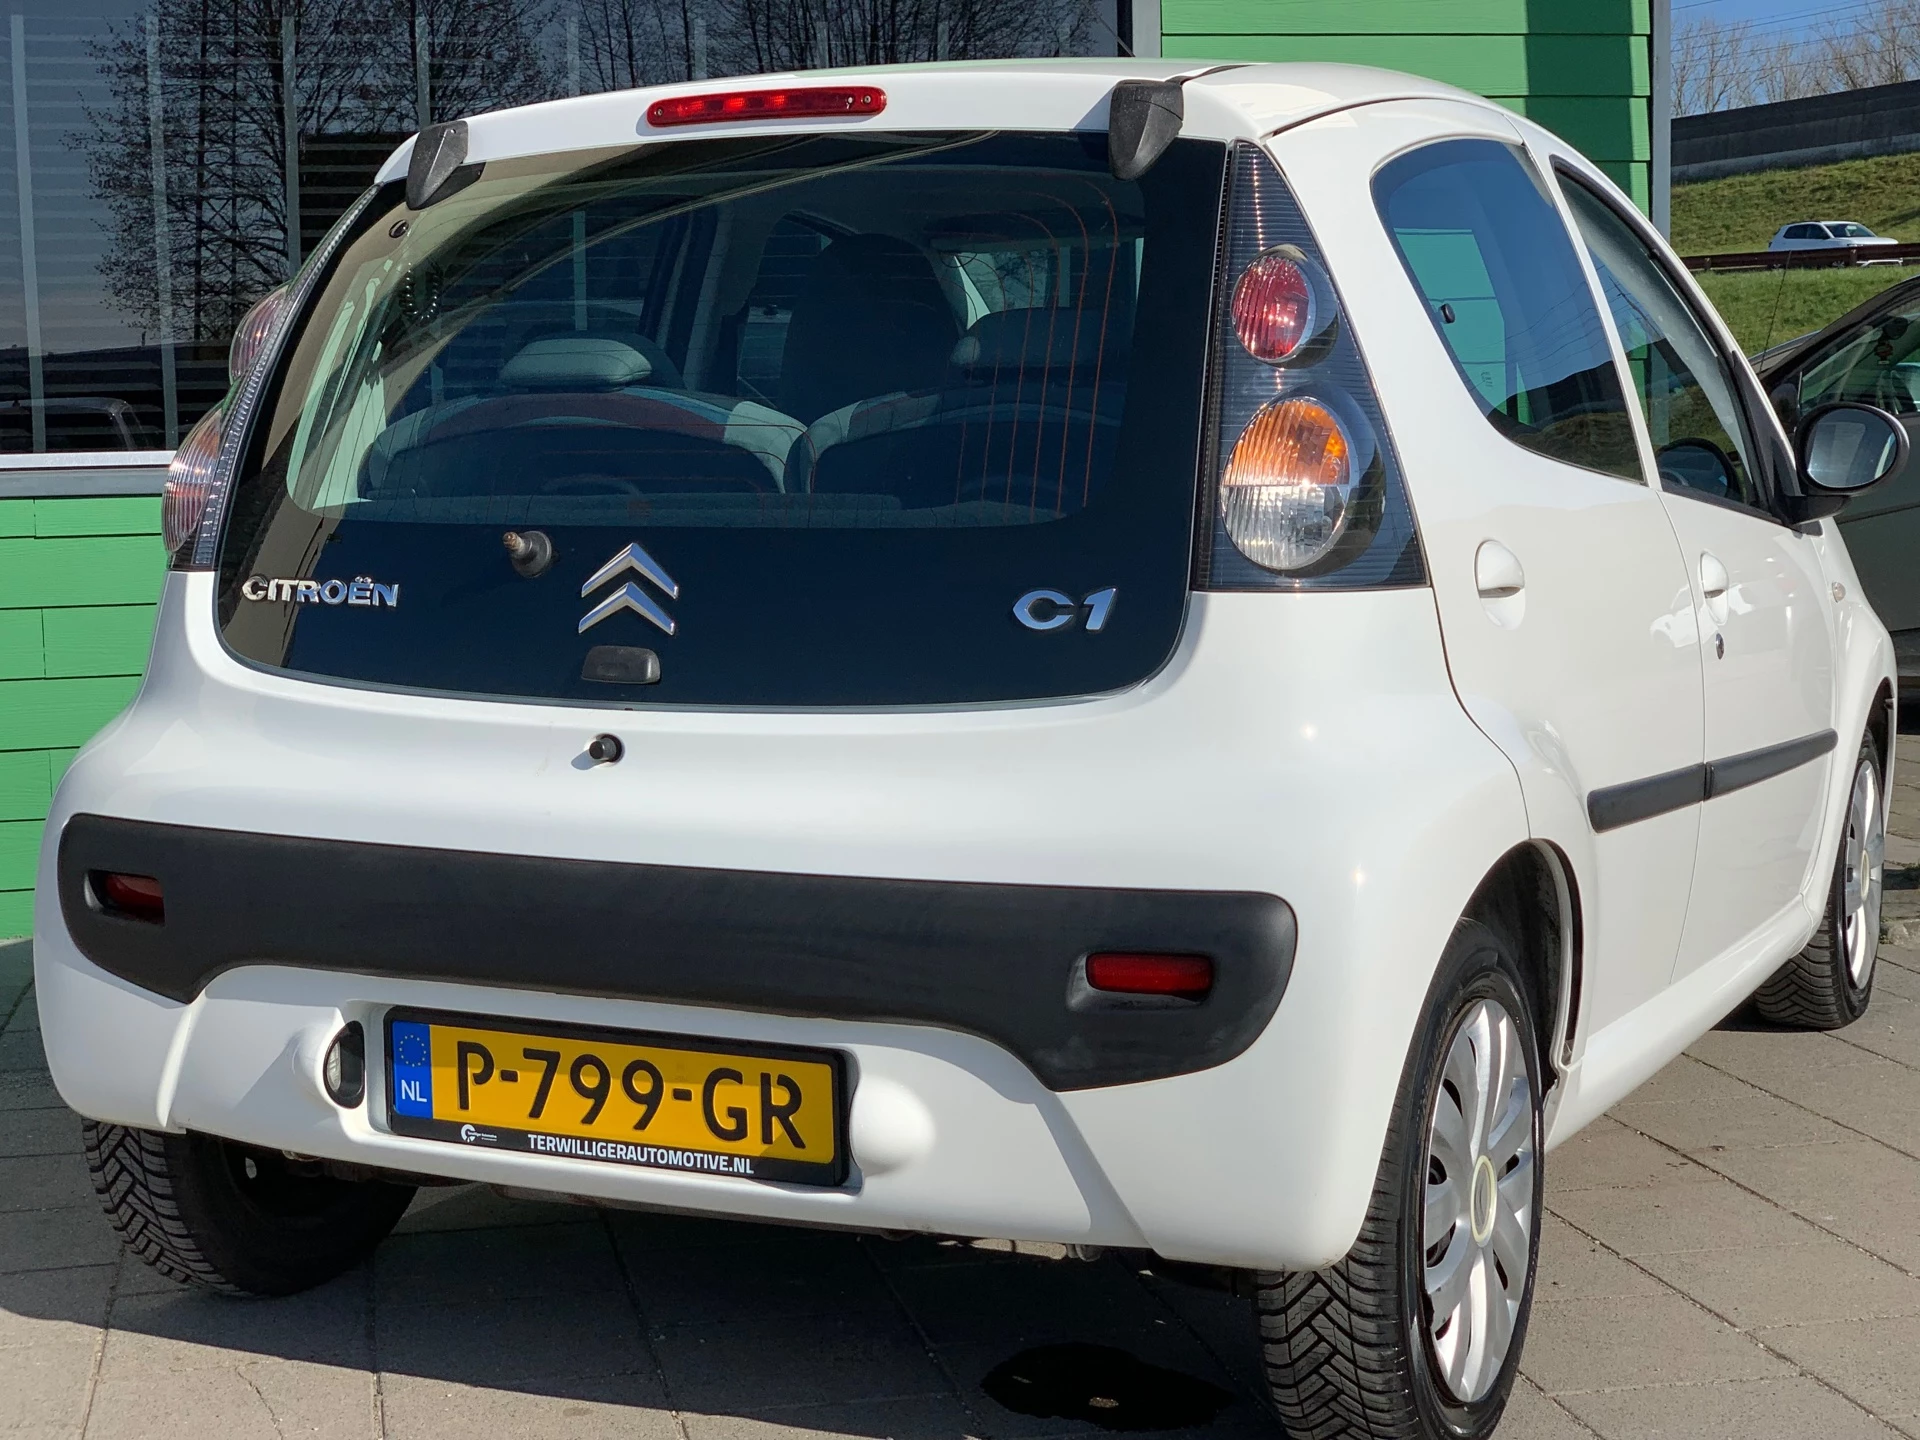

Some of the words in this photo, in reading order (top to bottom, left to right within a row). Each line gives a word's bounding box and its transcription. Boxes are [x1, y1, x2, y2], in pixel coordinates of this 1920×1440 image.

[242, 575, 400, 608] CITROËN
[1012, 587, 1118, 631] C1
[400, 1079, 428, 1103] NL
[457, 1040, 806, 1149] P-799-GR
[528, 1133, 755, 1175] TERWILLIGERAUTOMOTIVE.NL
